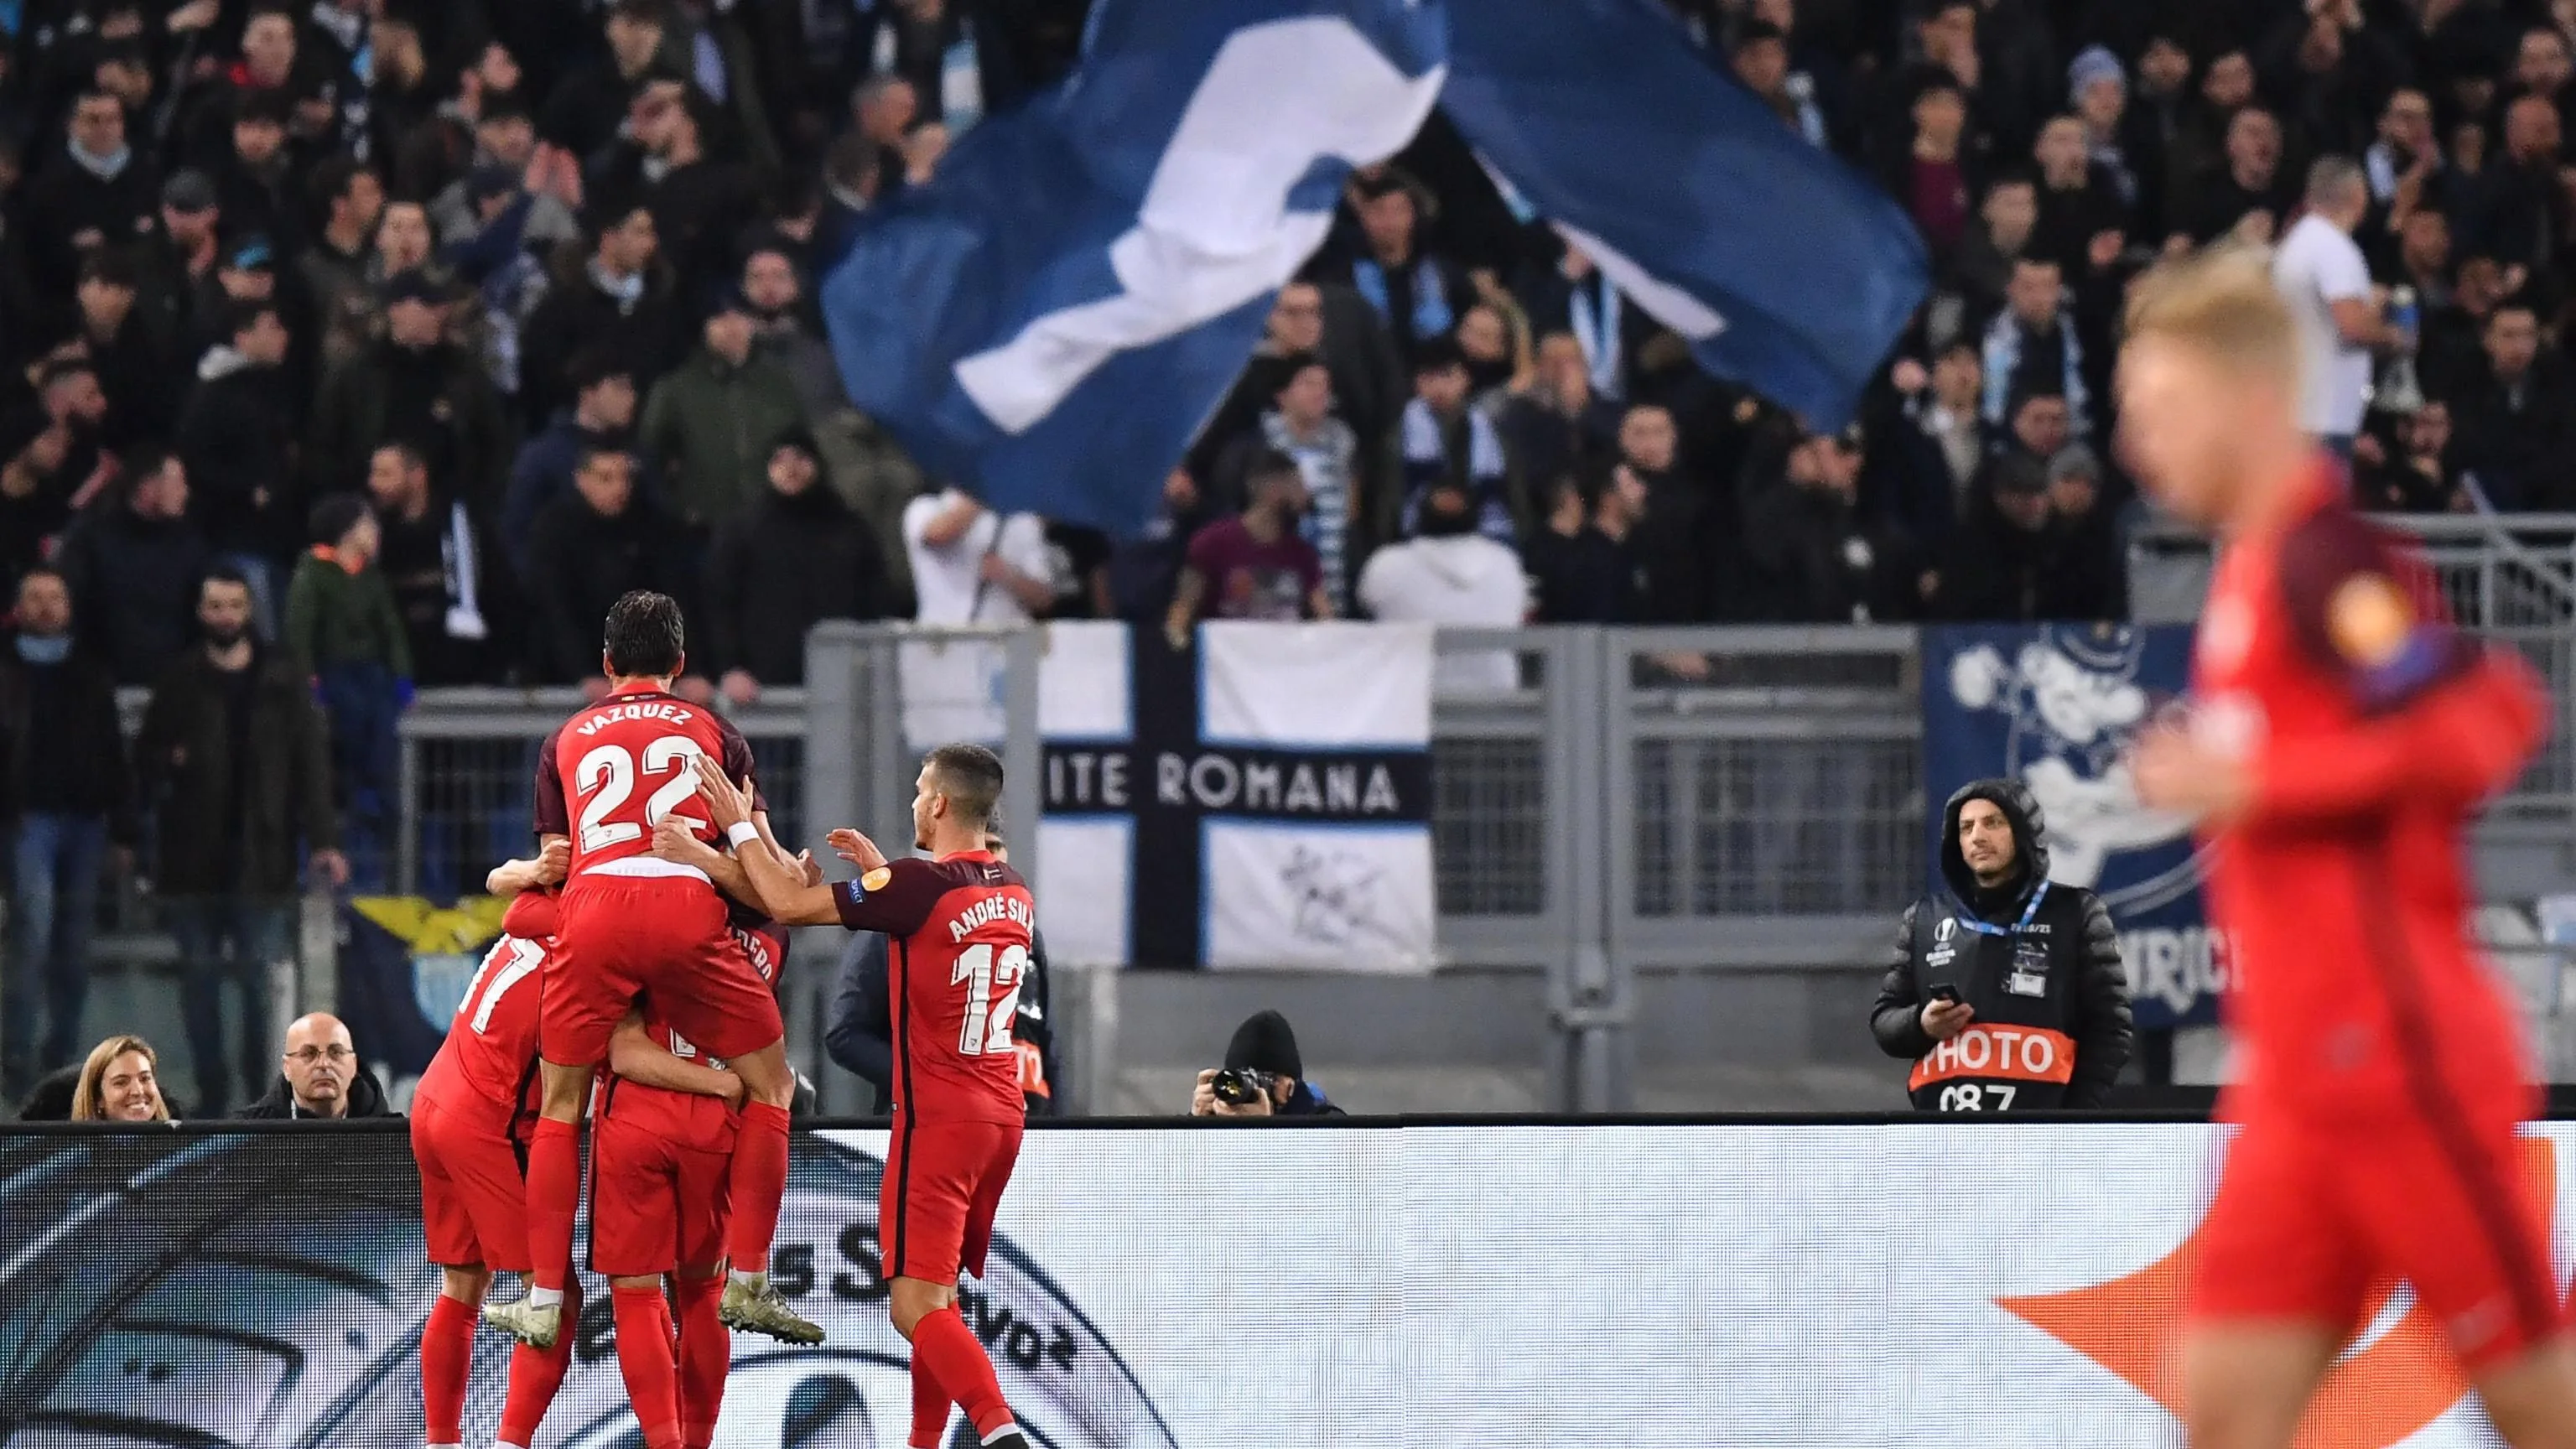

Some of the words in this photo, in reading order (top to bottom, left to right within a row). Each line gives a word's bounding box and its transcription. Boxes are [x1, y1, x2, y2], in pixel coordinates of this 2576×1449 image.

[577, 703, 693, 737] VAZQUEZ
[574, 735, 708, 855] 22
[1156, 753, 1401, 813] ROMANA
[948, 891, 1007, 943] ANDRÉ
[950, 943, 1028, 1056] 12
